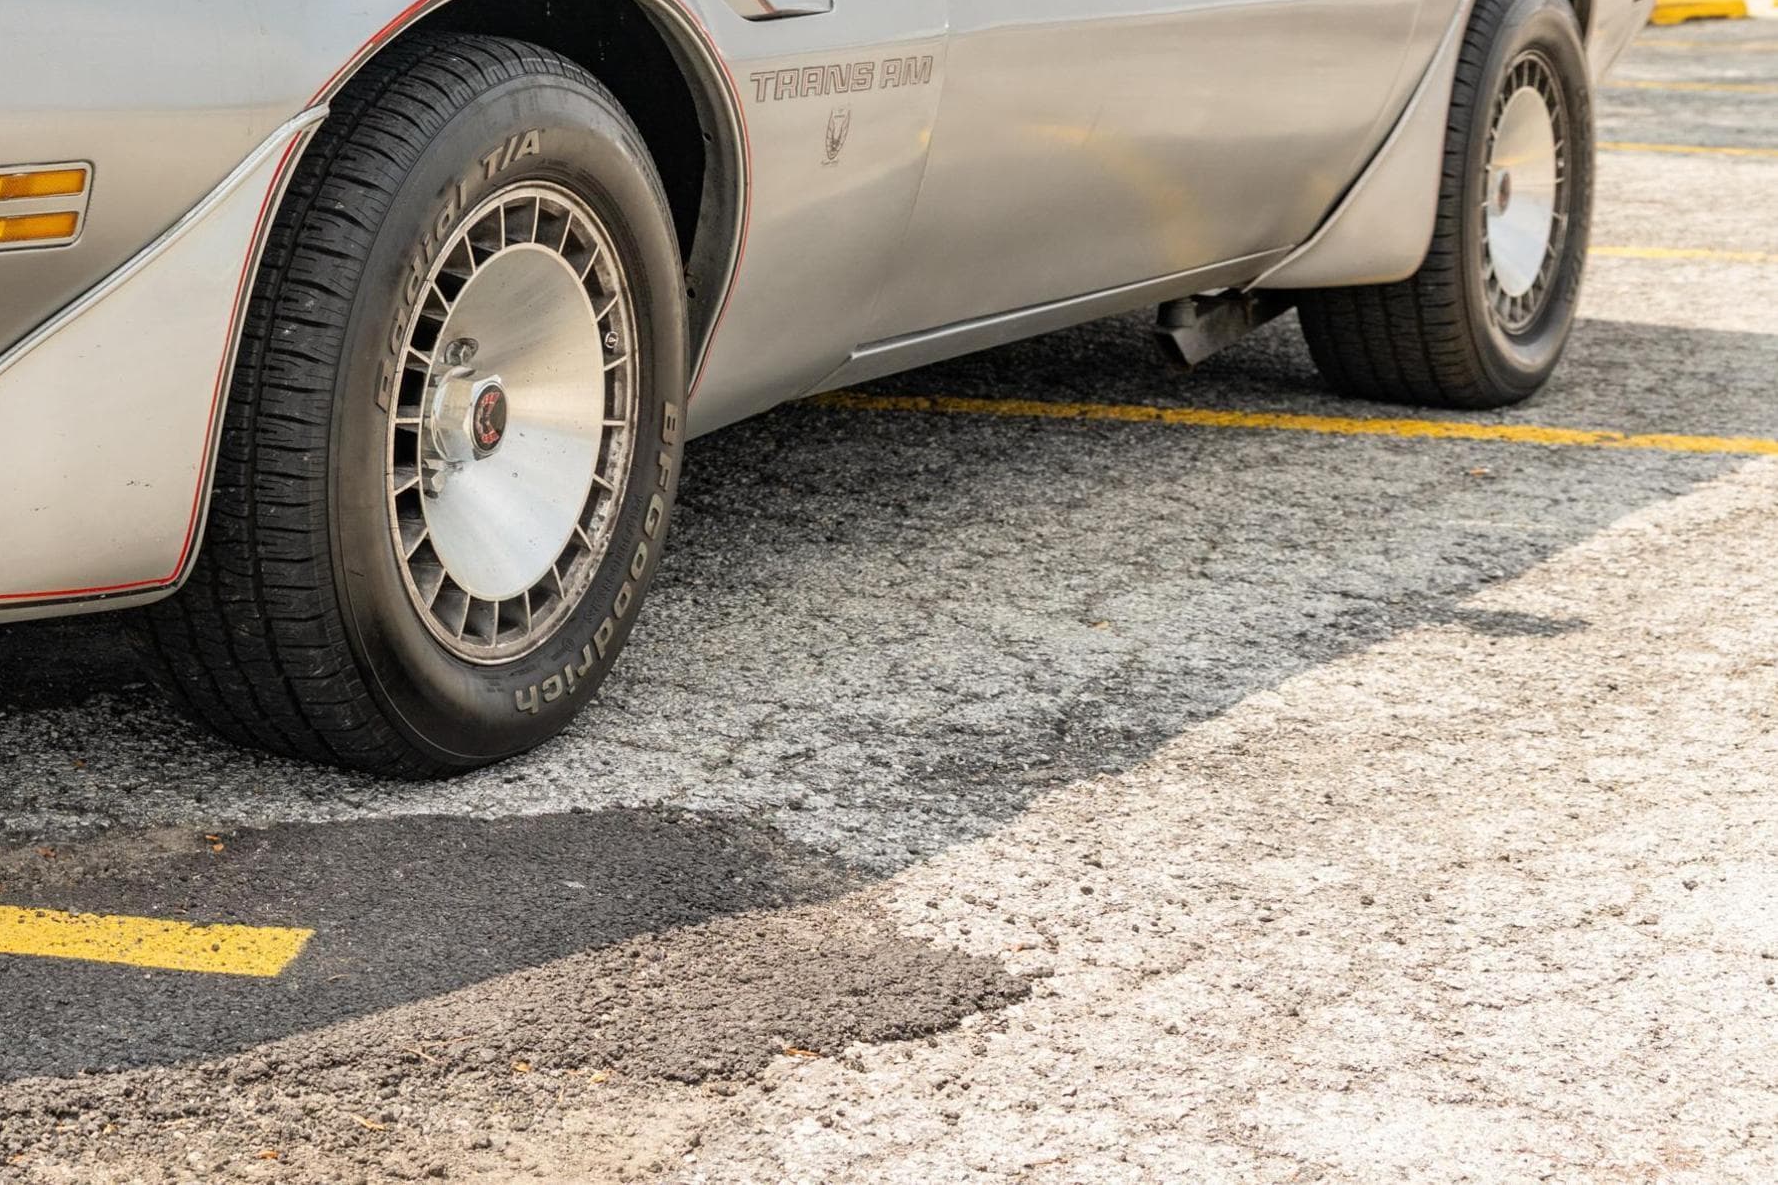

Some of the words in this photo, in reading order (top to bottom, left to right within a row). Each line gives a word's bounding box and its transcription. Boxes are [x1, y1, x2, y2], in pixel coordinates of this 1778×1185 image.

[750, 62, 875, 103] TRANS
[879, 56, 933, 89] AM
[375, 177, 469, 414] Radial
[479, 128, 541, 181] T/A
[515, 401, 679, 713] BFGoodrich
